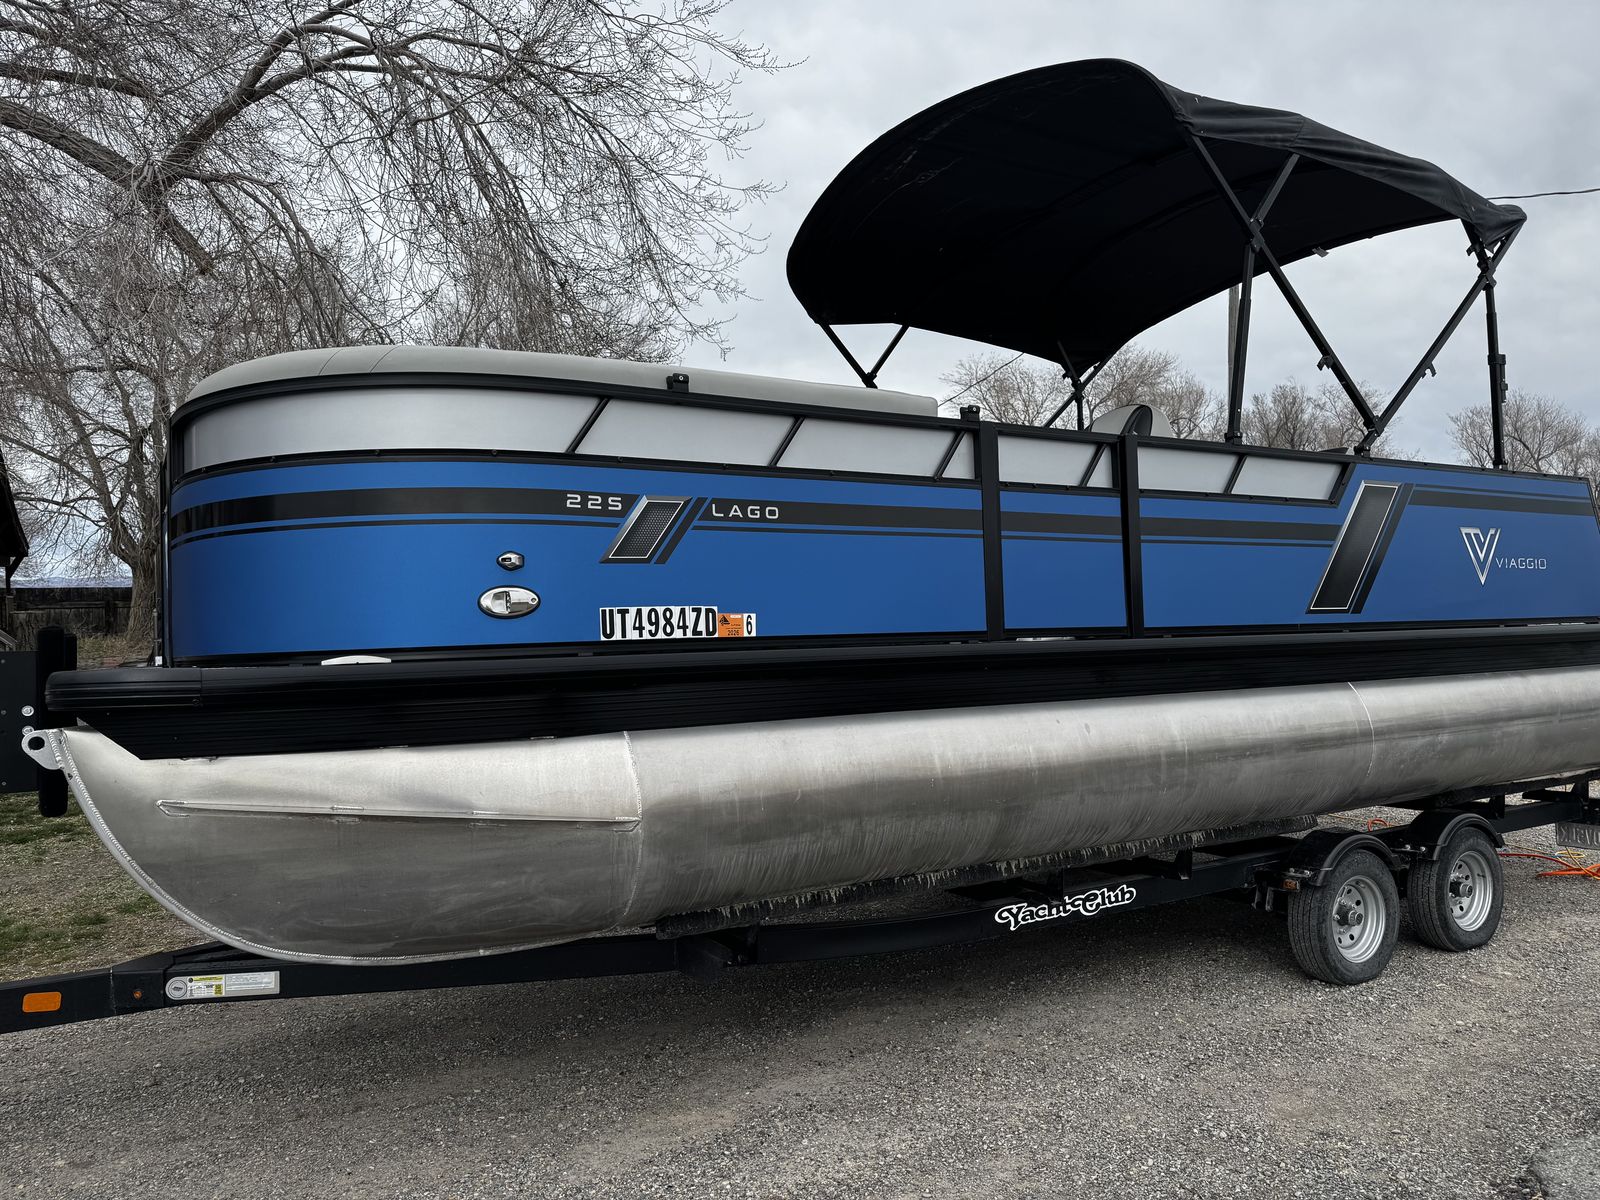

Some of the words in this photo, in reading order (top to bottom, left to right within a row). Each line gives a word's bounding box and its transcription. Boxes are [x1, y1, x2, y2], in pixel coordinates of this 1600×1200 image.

[711, 503, 779, 519] LAGO
[1495, 557, 1547, 569] VIAGGIO
[601, 608, 717, 639] UT4984ZD
[745, 614, 753, 636] 6
[995, 896, 1073, 930] Yacht
[1071, 885, 1136, 915] Club
